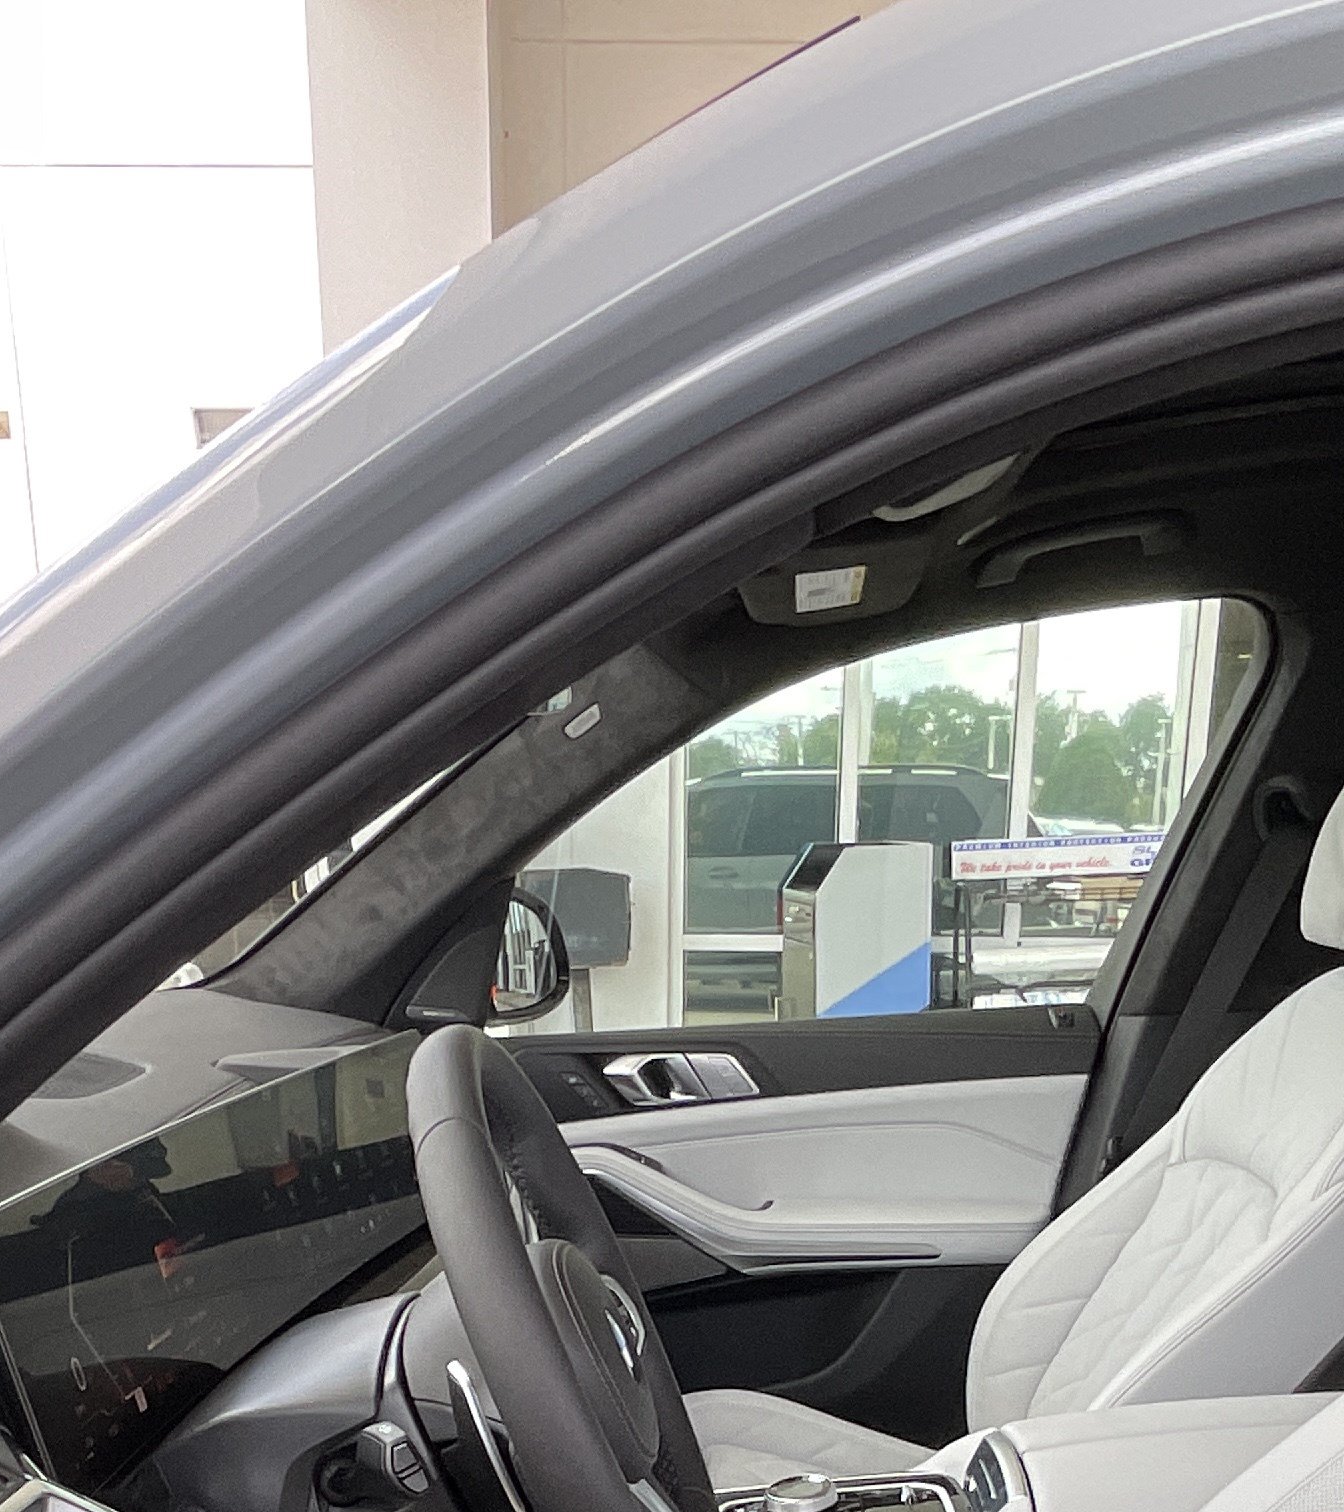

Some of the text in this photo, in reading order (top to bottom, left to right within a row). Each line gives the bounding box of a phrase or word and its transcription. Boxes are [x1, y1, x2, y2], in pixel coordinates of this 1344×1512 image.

[980, 861, 1002, 872] take
[1005, 861, 1033, 873] pride
[1035, 861, 1047, 871] in
[1049, 862, 1072, 872] your
